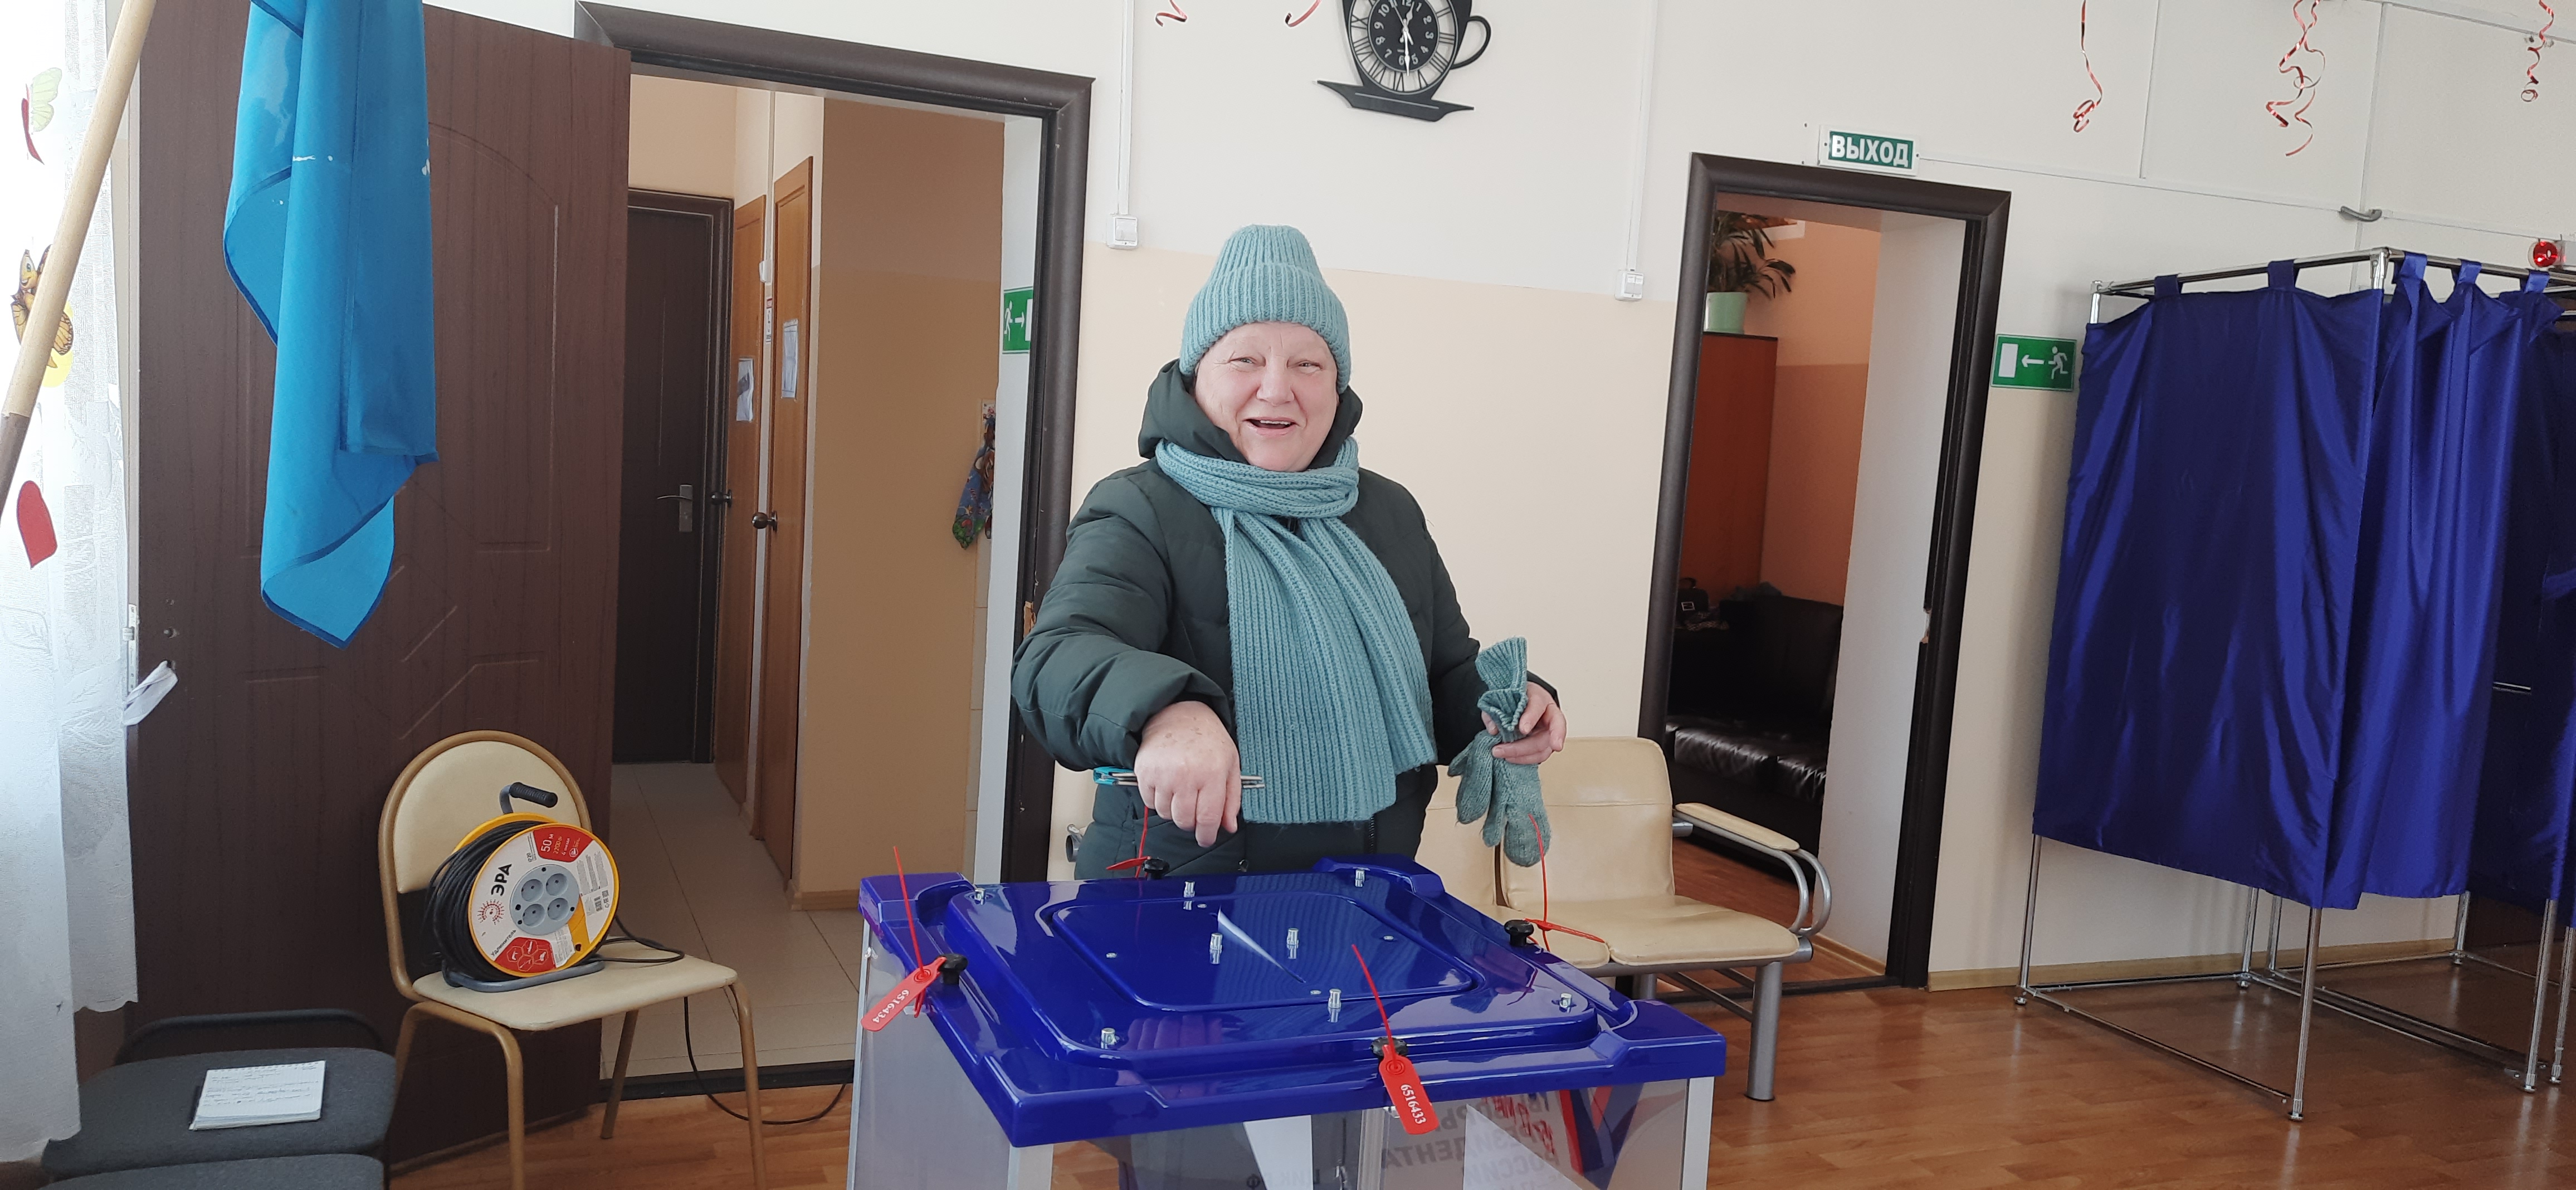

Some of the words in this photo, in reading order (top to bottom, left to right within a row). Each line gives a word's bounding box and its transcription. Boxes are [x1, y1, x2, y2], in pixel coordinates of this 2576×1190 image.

[1378, 3, 1389, 17] 10
[1416, 2, 1422, 12] 1
[1374, 21, 1384, 30] 9
[1423, 15, 1432, 25] 2
[1375, 36, 1386, 45] 8
[1425, 31, 1434, 40] 3
[1384, 48, 1393, 58] 7
[1420, 45, 1429, 53] 4
[1398, 55, 1404, 66] 6
[1411, 53, 1419, 65] 5
[1832, 134, 1909, 167] ВЫХОД
[541, 839, 552, 852] 50
[491, 863, 513, 897] ЭРА
[871, 988, 910, 1024] 6516434
[1399, 1082, 1427, 1125] 6516433
